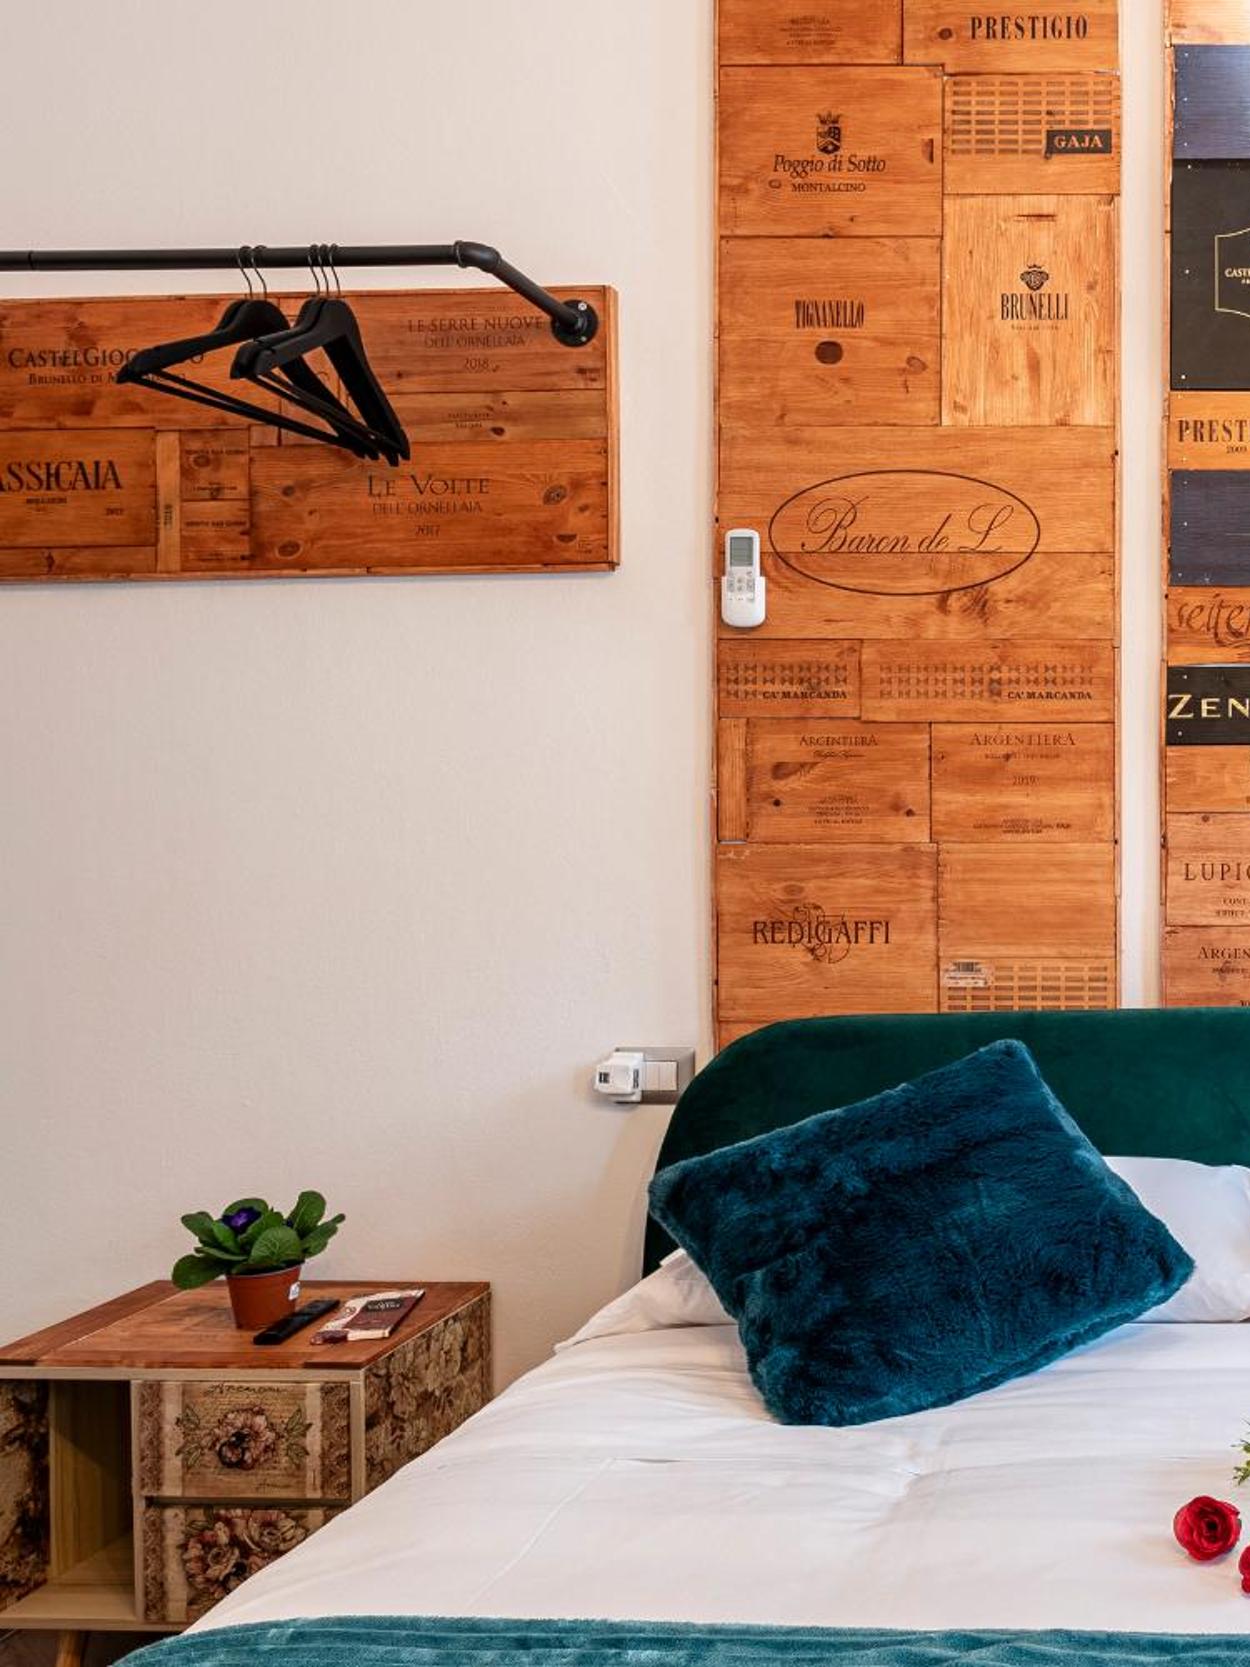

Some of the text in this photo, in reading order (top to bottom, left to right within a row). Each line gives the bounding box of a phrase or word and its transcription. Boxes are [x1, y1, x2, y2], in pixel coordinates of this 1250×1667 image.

[969, 15, 1088, 40] PRESTIGIO
[1053, 135, 1103, 149] GAJA
[773, 154, 886, 179] Poggio di Sotto
[791, 182, 866, 193] MONTALCINO
[1000, 293, 1069, 321] BRUNELLI
[425, 318, 476, 333] SERRE
[483, 316, 543, 331] NUOVE
[455, 333, 526, 348] ORNELLAIA
[8, 347, 205, 369] CASTELGIOCO
[368, 474, 490, 497] LE VOLTE
[407, 501, 483, 515] ORNELLAIA
[801, 496, 912, 554] Baron
[917, 513, 952, 554] de
[799, 734, 879, 747] ARGENTIERA
[970, 732, 1077, 747] ARGENTIERA
[752, 921, 891, 945] REDIGAFFI
